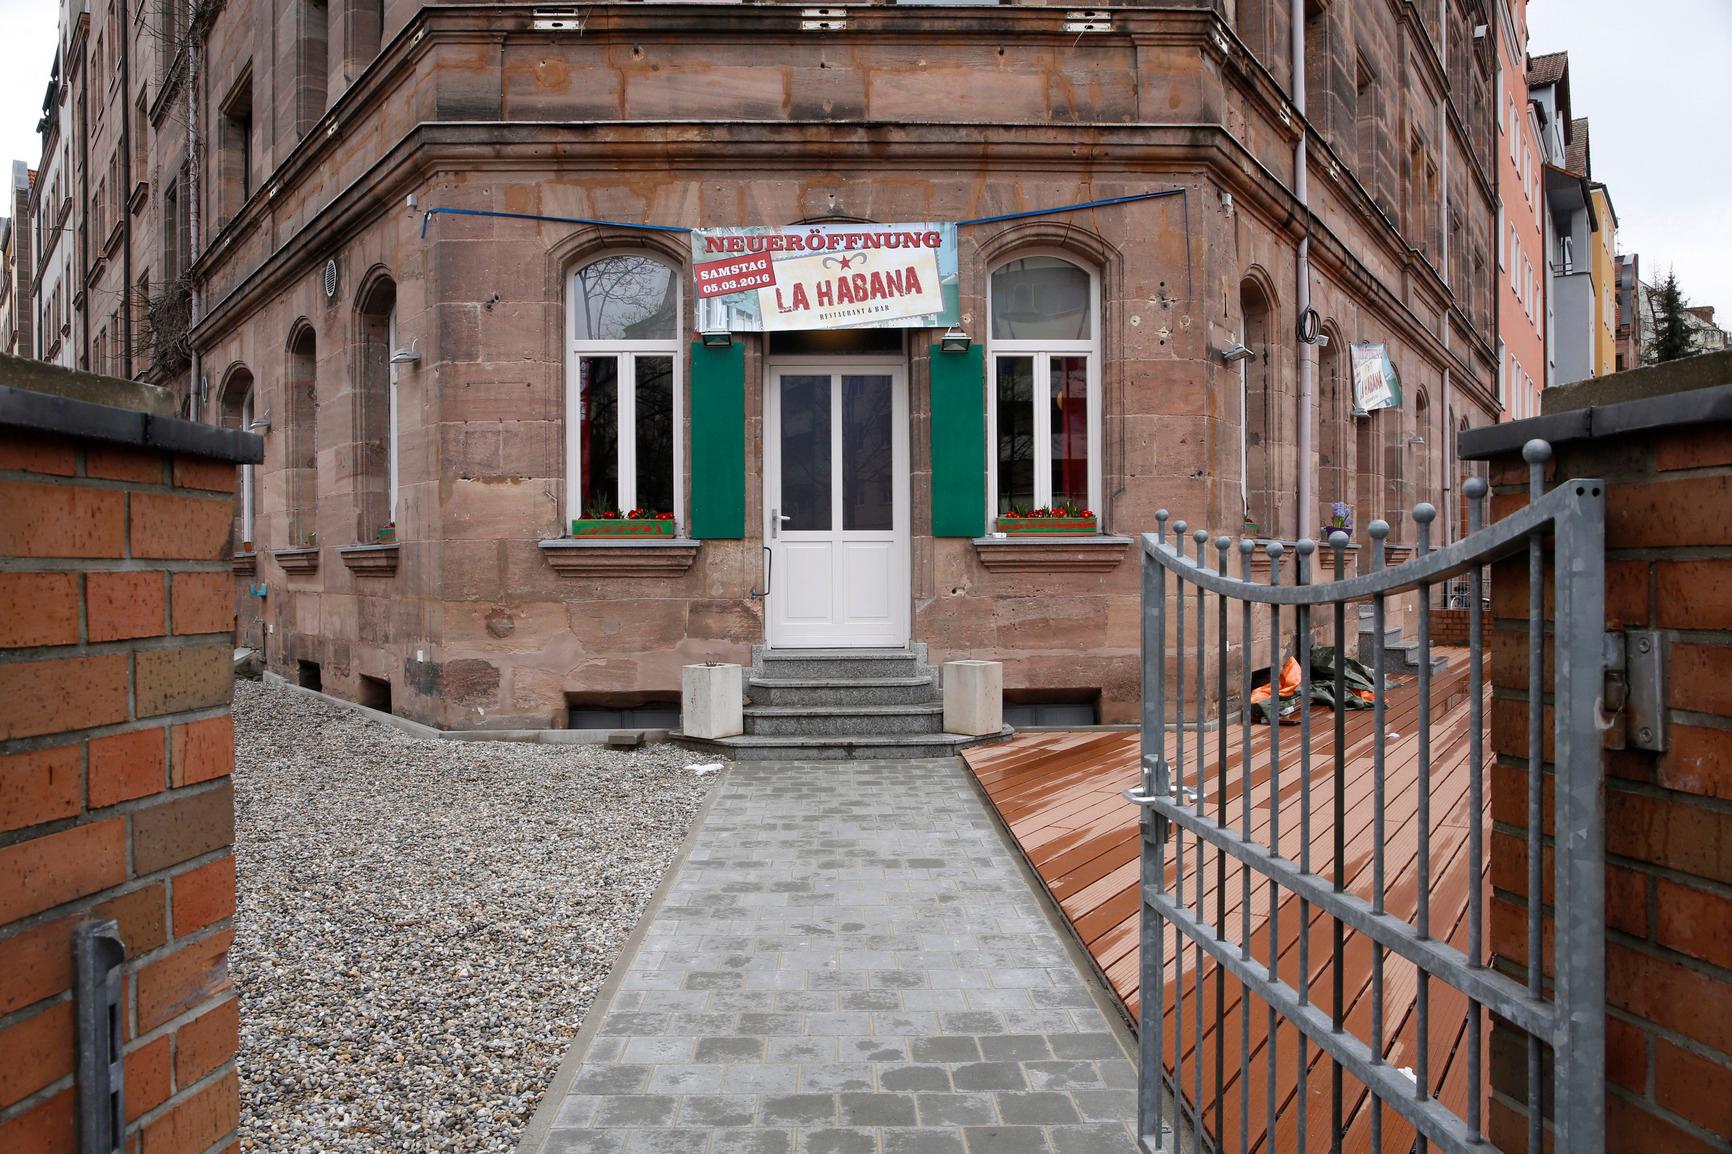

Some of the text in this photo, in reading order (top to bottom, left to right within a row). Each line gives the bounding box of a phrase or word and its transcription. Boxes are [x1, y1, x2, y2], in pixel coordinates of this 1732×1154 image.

[704, 228, 942, 254] NEUERÖFFNUNG
[700, 260, 767, 281] SAMSTAG
[703, 274, 770, 294] 05.03.2016
[775, 266, 923, 314] LA HABANA
[819, 304, 890, 320] RESTAURANT & BAR
